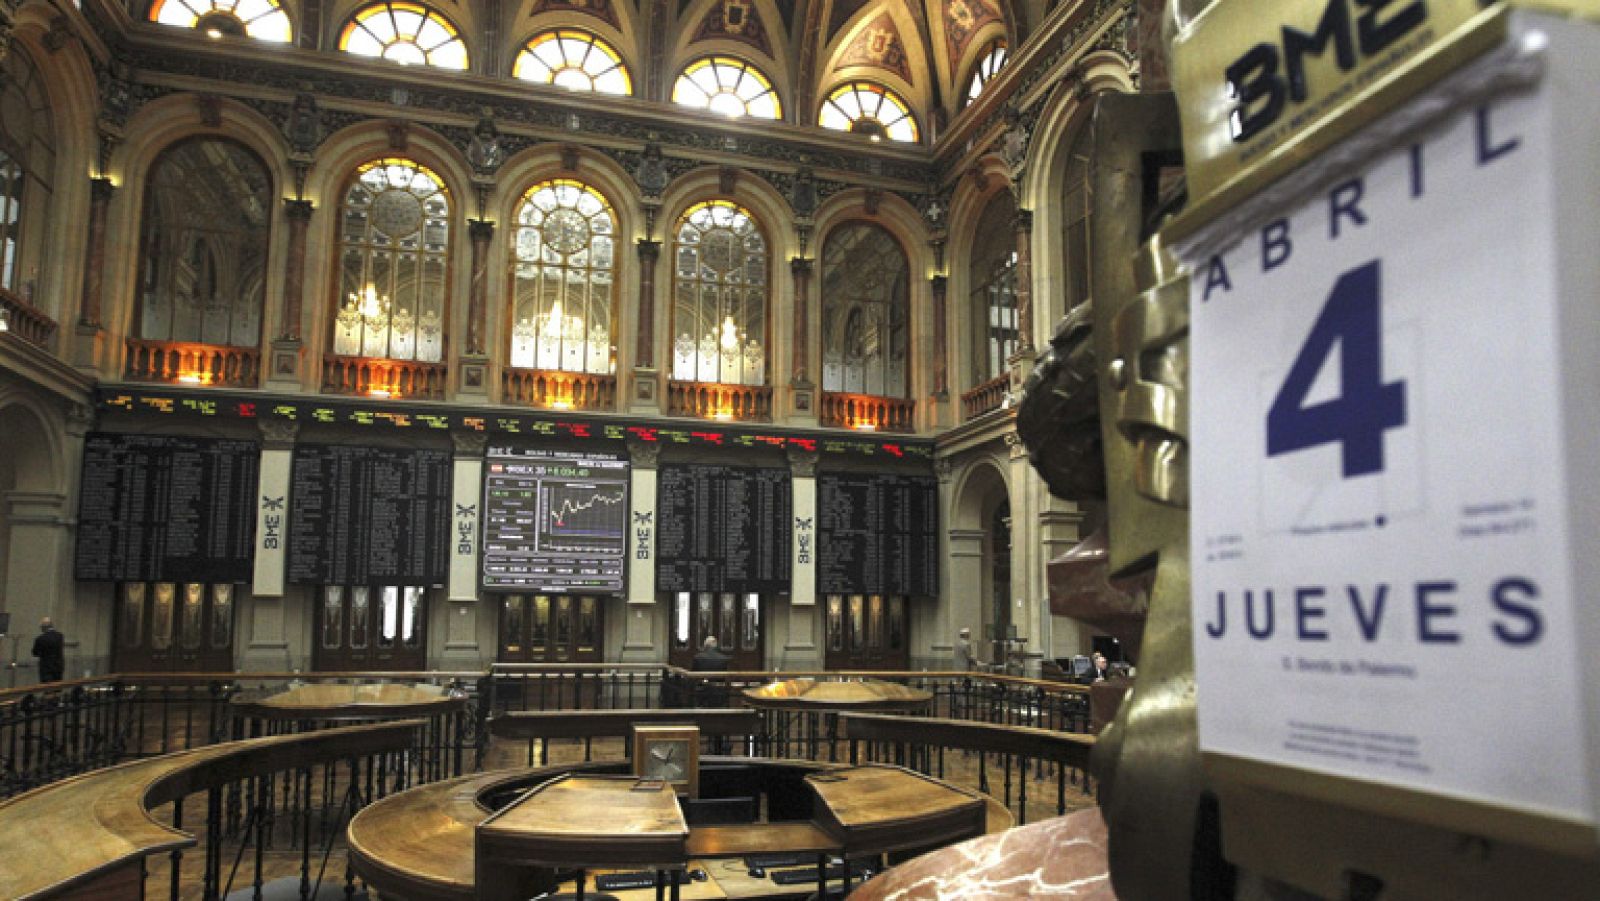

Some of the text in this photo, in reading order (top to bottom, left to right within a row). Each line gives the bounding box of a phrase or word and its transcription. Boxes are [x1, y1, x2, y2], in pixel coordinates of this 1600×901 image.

[1226, 0, 1428, 142] BME
[1203, 102, 1521, 302] ABRIL
[1266, 257, 1407, 480] 4
[264, 514, 280, 549] BME
[457, 520, 473, 556] BME
[636, 527, 650, 560] BME
[1206, 577, 1545, 648] JUEVES
